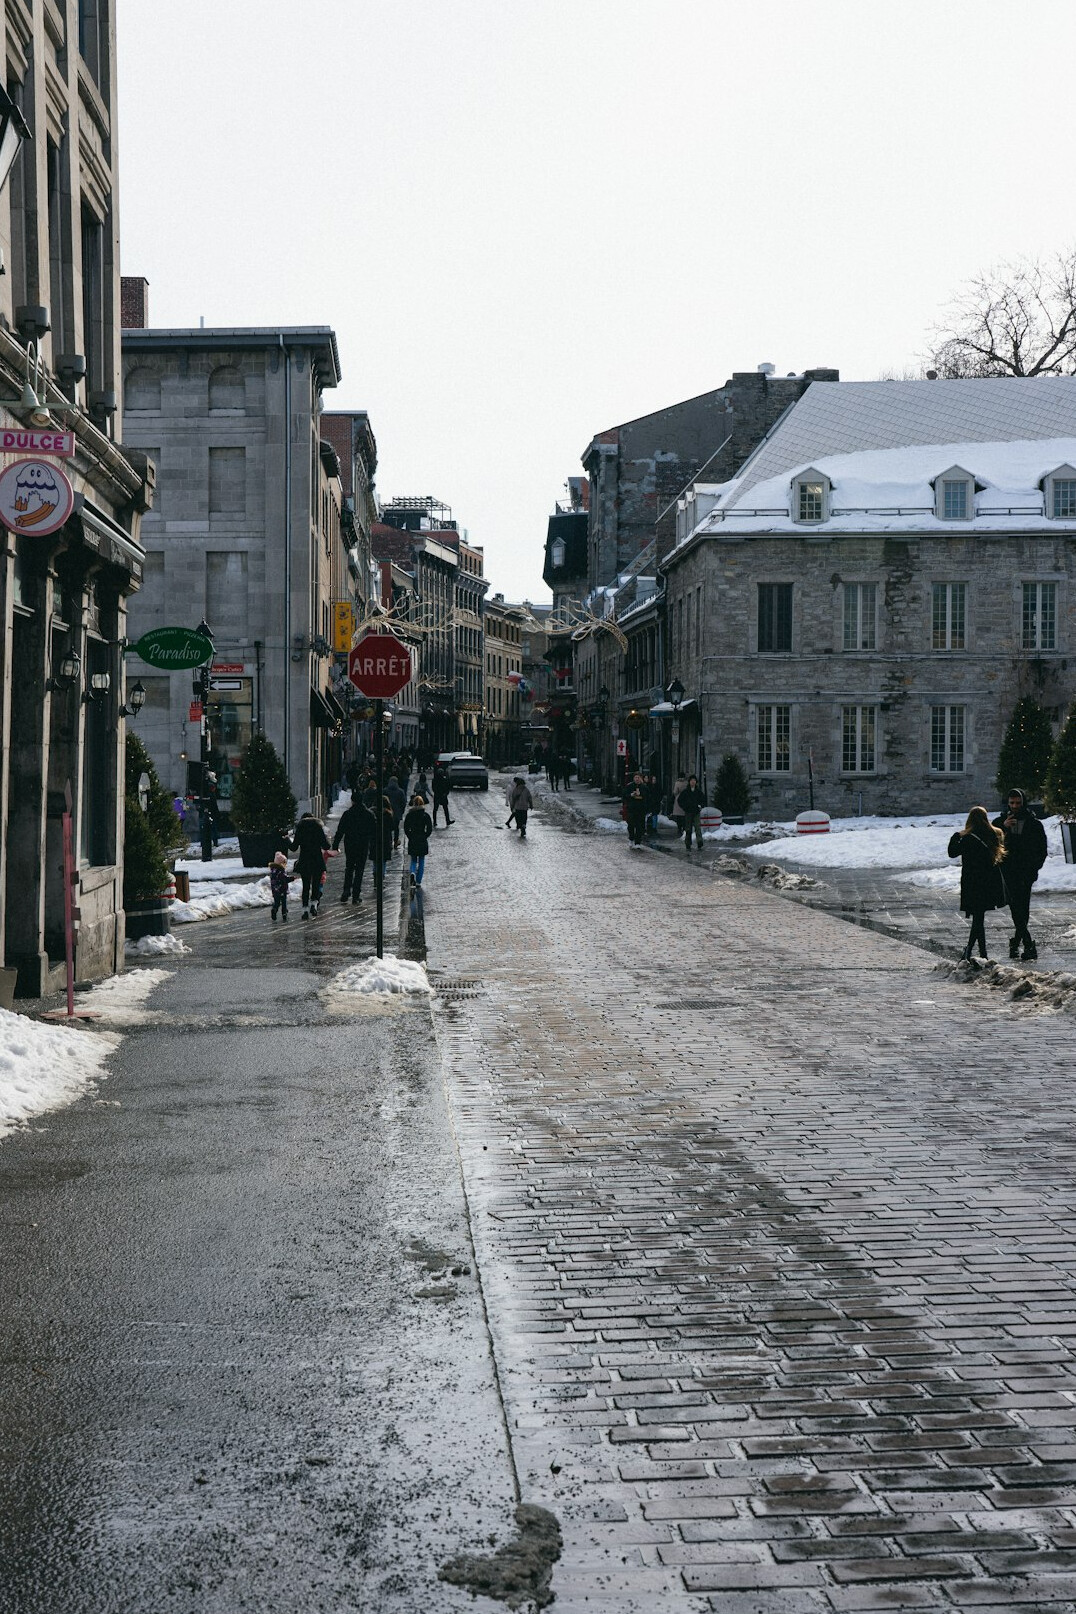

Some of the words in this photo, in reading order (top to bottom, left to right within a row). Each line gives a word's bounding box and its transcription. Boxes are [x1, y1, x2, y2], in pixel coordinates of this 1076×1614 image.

[3, 433, 64, 450] DULCE
[144, 630, 177, 641] RESTAURANT
[184, 631, 205, 642] PIZZERIA
[149, 641, 201, 660] Paradiso
[352, 655, 409, 676] ARRÊT
